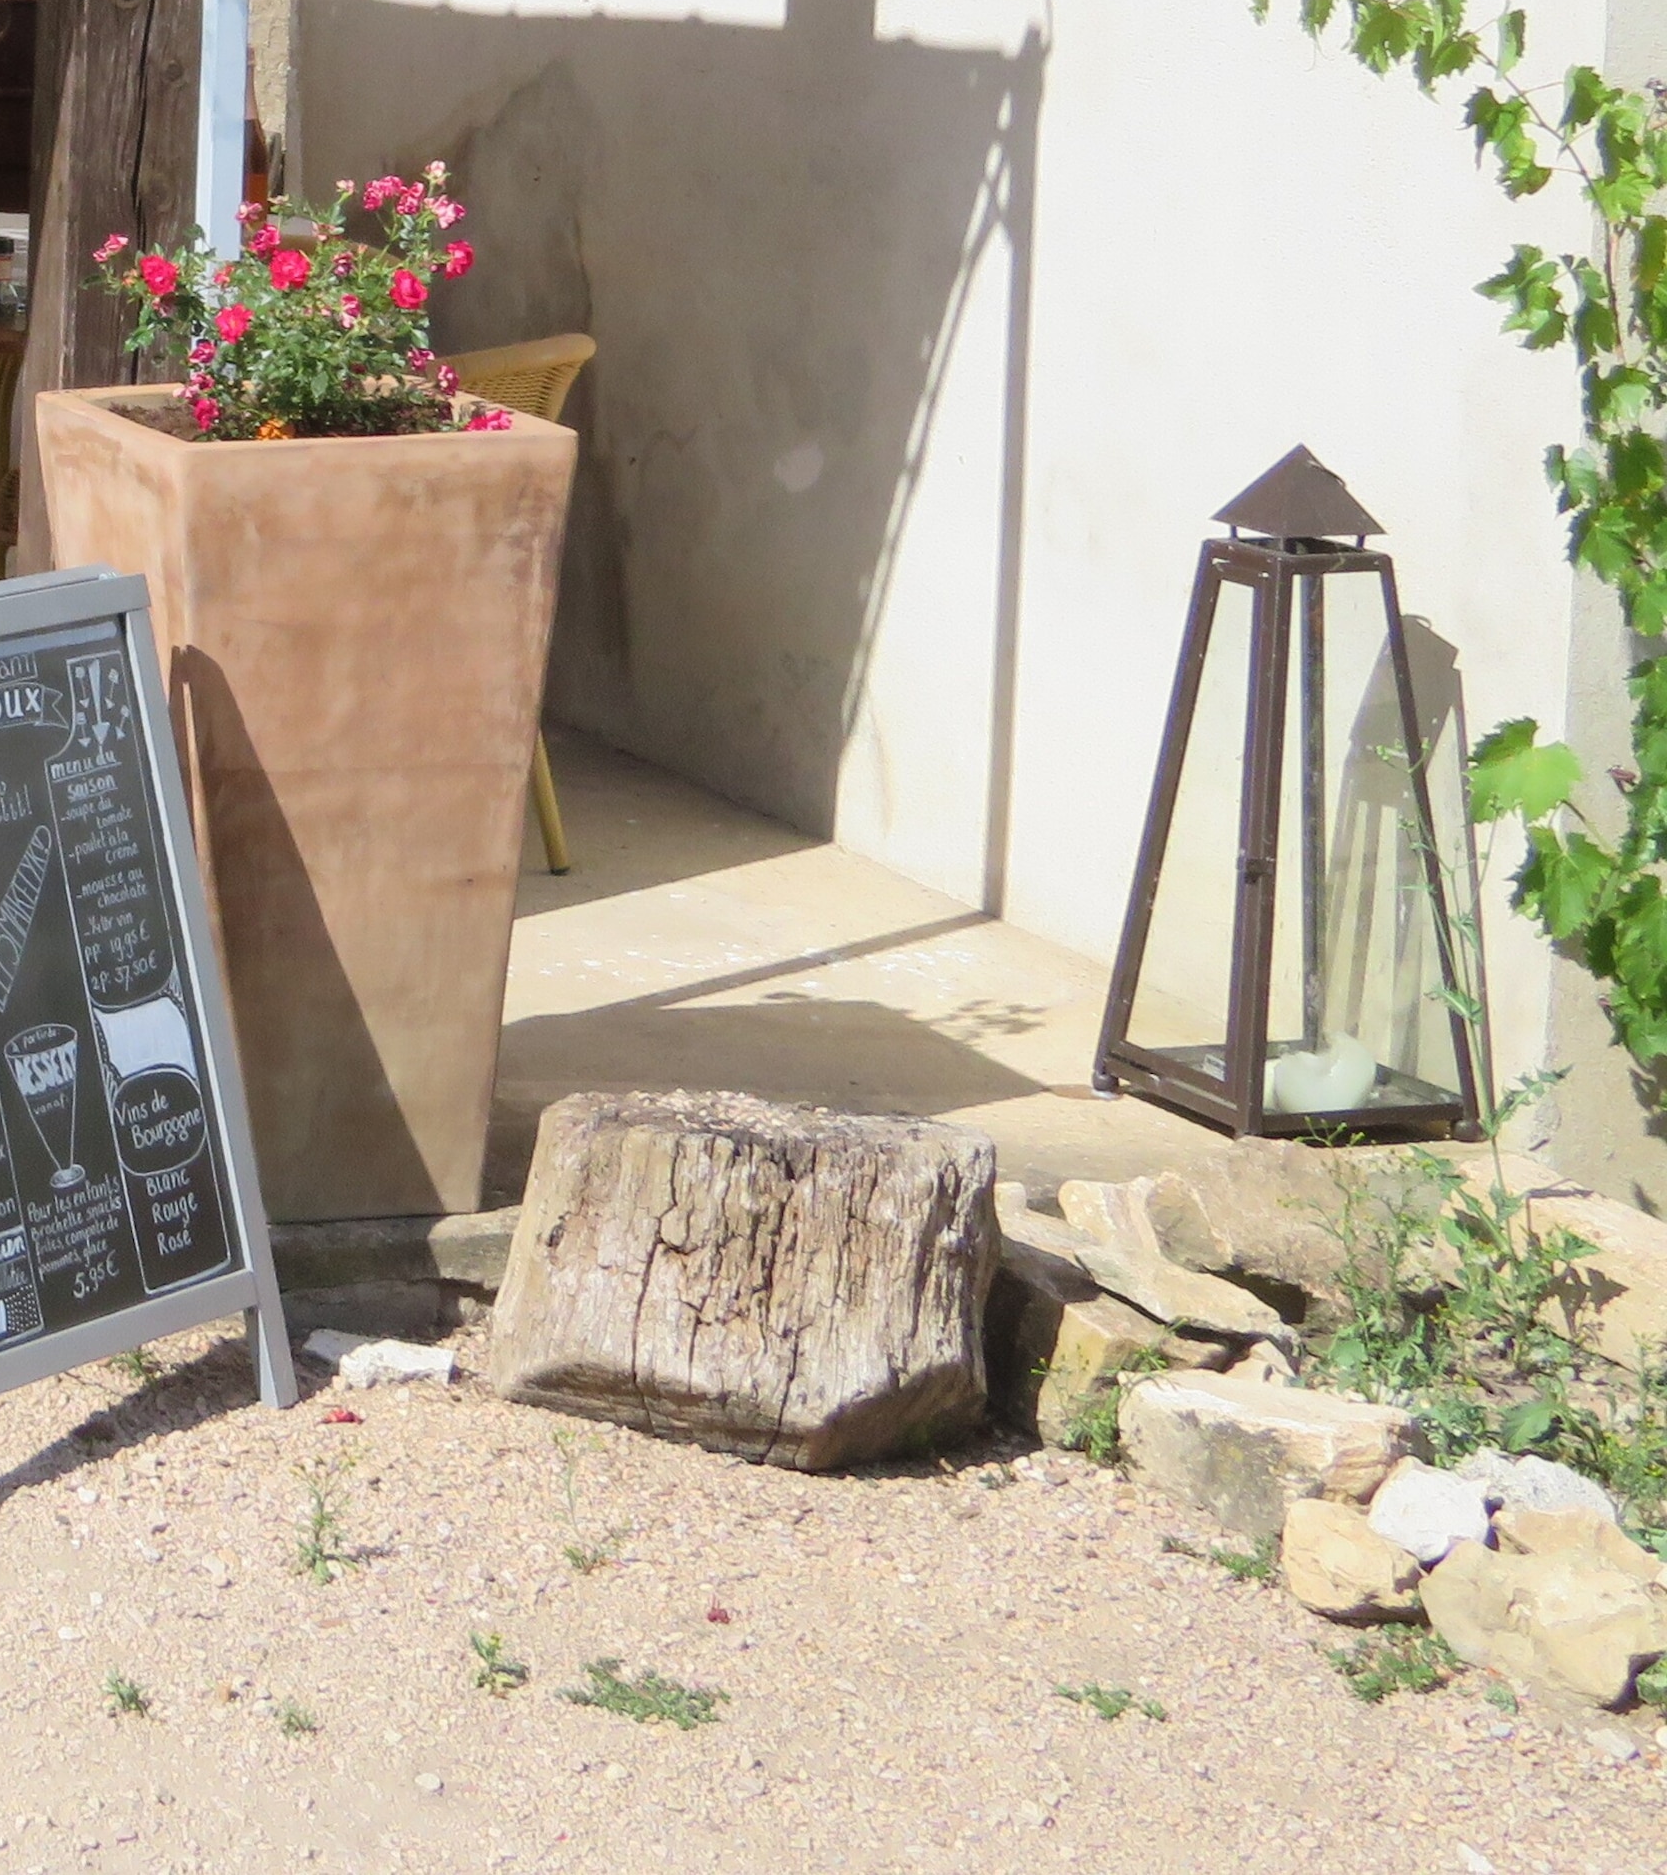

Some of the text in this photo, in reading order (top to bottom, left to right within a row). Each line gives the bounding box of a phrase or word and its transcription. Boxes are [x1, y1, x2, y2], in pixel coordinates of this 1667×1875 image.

[50, 746, 117, 780] menu du
[67, 775, 116, 802] saison
[115, 1087, 169, 1127] Vins de
[131, 1107, 202, 1150] Bourgogne
[27, 1172, 121, 1223] Pour les enfants
[145, 1167, 191, 1197] Blanc
[151, 1190, 199, 1224] Rouge
[157, 1225, 193, 1256] Rosé
